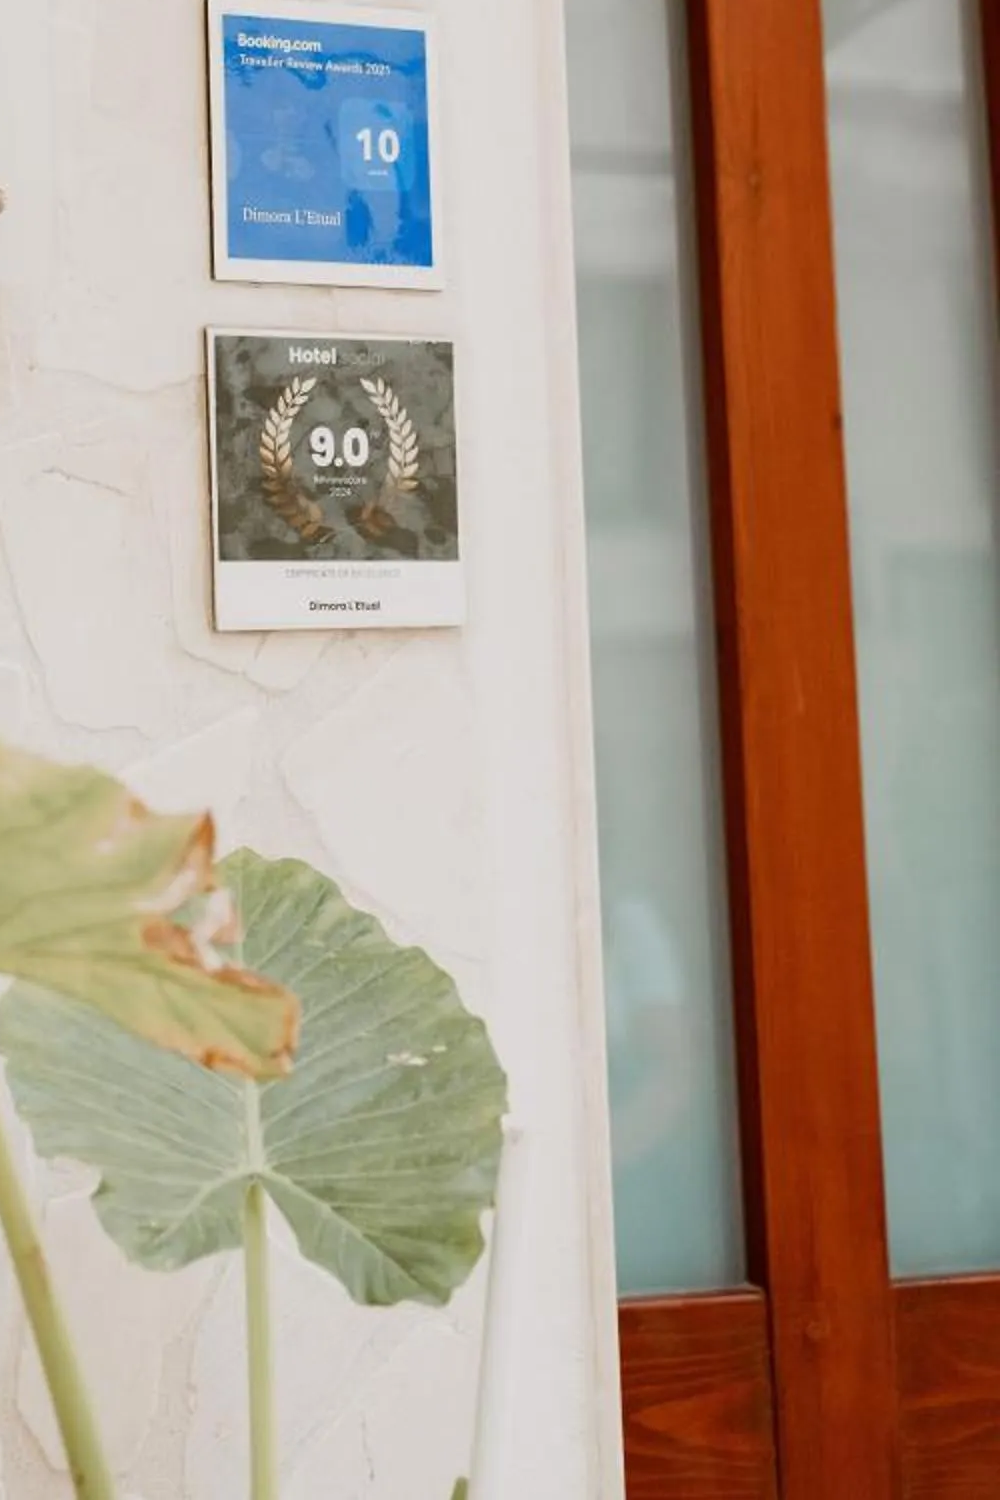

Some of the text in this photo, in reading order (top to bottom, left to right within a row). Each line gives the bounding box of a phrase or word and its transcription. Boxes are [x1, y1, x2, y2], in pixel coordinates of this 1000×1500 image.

[237, 33, 322, 53] Booking.com
[286, 56, 323, 71] Review
[325, 60, 363, 75] Awards
[355, 127, 400, 163] 10
[243, 207, 342, 226] Dimora L'Etual
[288, 346, 337, 365] Hotel
[309, 426, 370, 467] 9.0
[309, 600, 347, 611] Dimora
